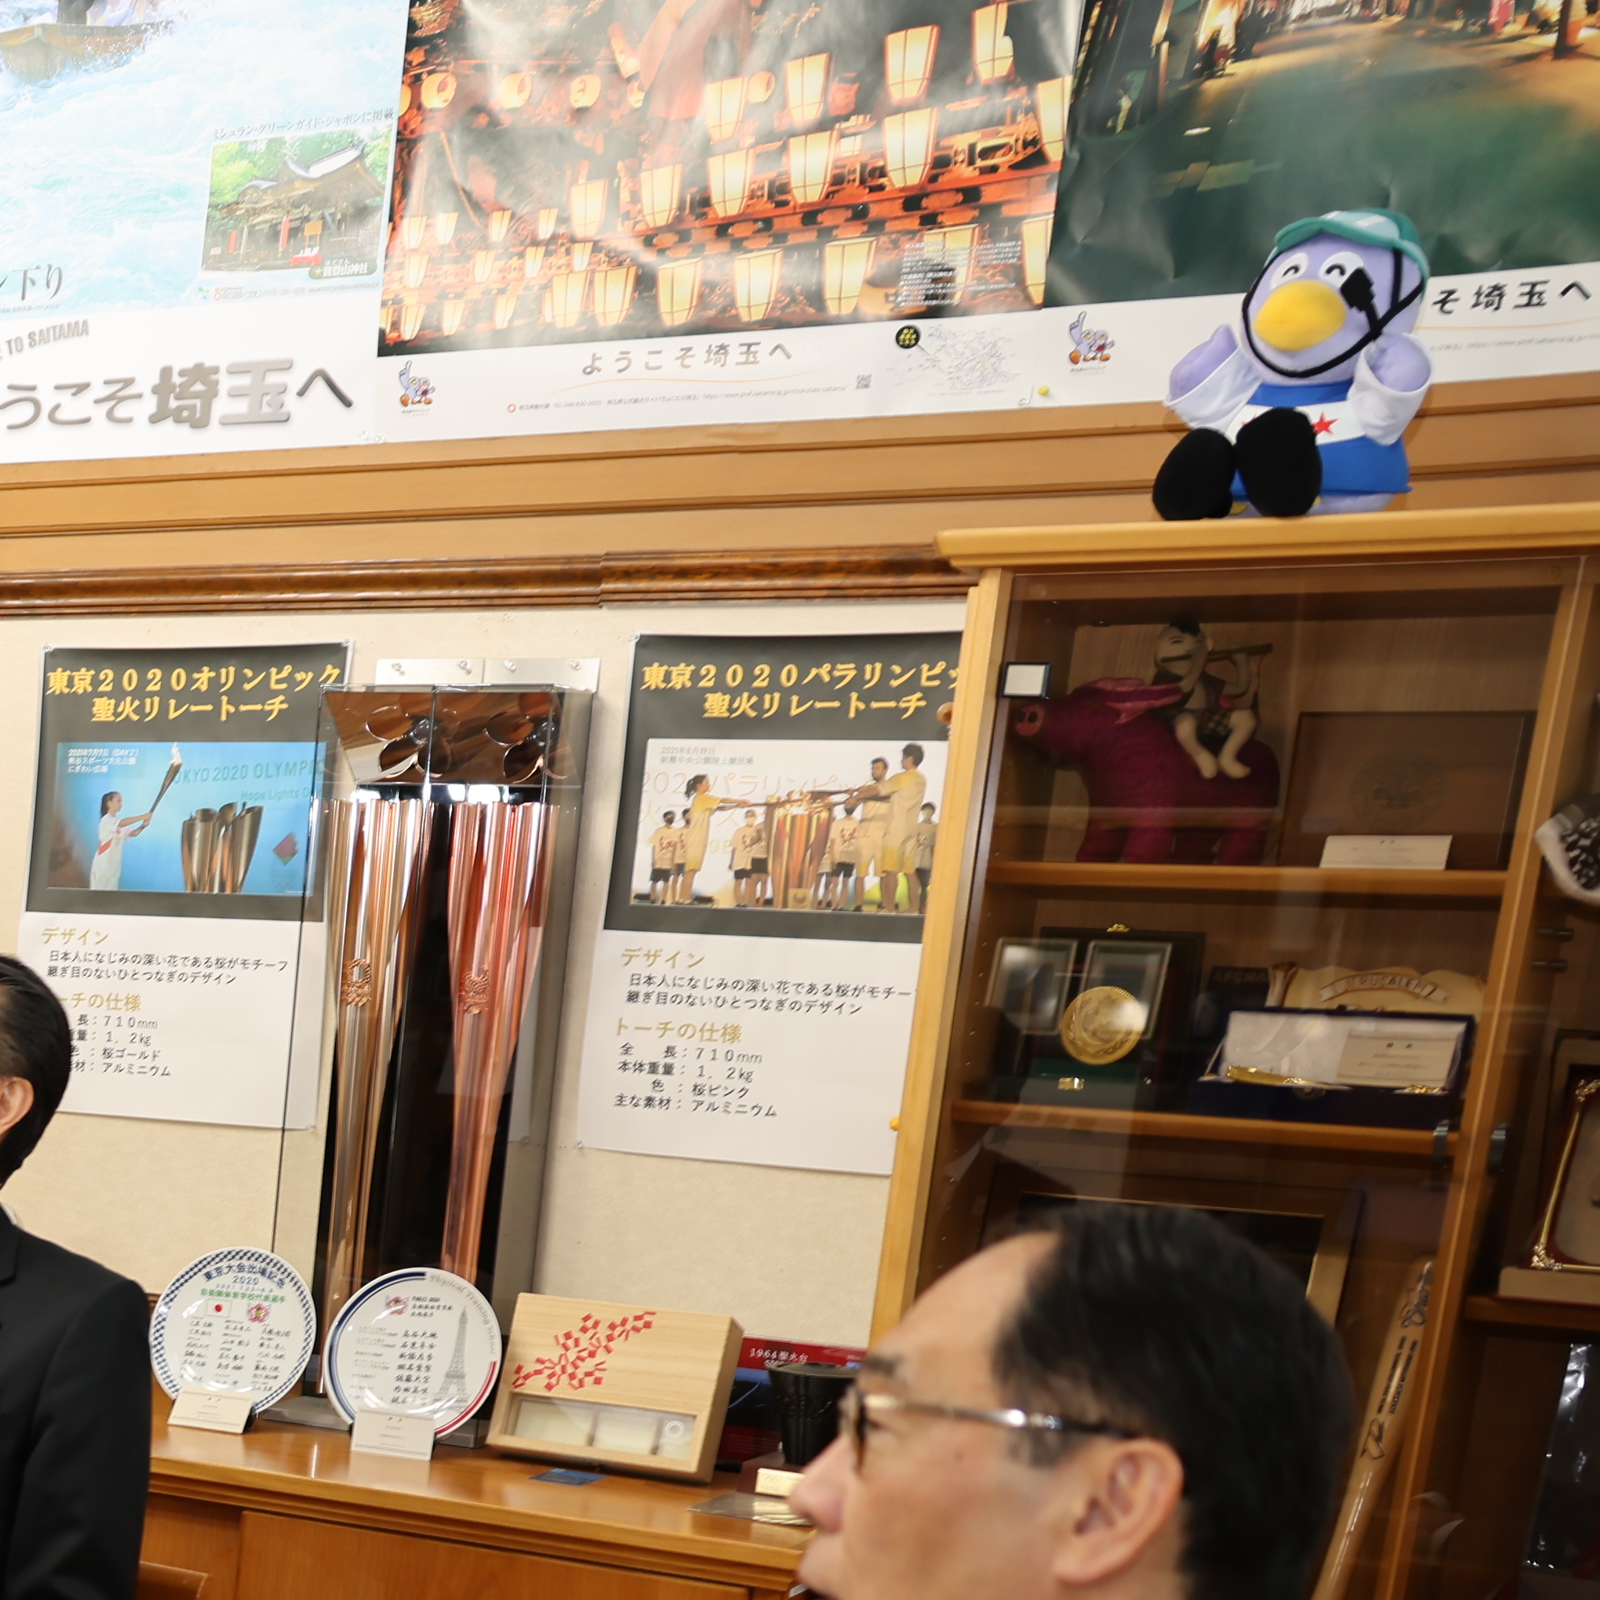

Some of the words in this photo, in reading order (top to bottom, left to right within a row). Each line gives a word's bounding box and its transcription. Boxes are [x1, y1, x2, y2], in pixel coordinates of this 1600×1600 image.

[1430, 280, 1593, 314] そ埼玉へ
[6, 335, 25, 355] TO
[28, 319, 90, 348] SAITAMA
[582, 341, 793, 375] ようこそ埼玉へ
[46, 664, 341, 695] 東京2020オリンピック
[91, 695, 289, 724] 聖火リレートーチ
[702, 692, 927, 719] 聖火リレートーチ
[211, 764, 249, 782] 2020
[241, 790, 266, 802] Hope
[268, 789, 300, 801] Lights
[41, 927, 110, 946] デザイン
[49, 949, 289, 972] 日本人になじみの深い花である桜がモチーフ
[620, 947, 706, 969] デザイン
[47, 965, 237, 985] 継ぎ目のないひとつなぎのデザイン
[629, 973, 918, 1000] 日本人になじみの深い花である桜がモチー
[626, 990, 863, 1015] 継ぎ目のないひとつなぎのデザイン
[616, 1017, 743, 1044] トーチの仕様
[233, 1275, 260, 1286] 2020
[429, 1273, 466, 1293] Physical
